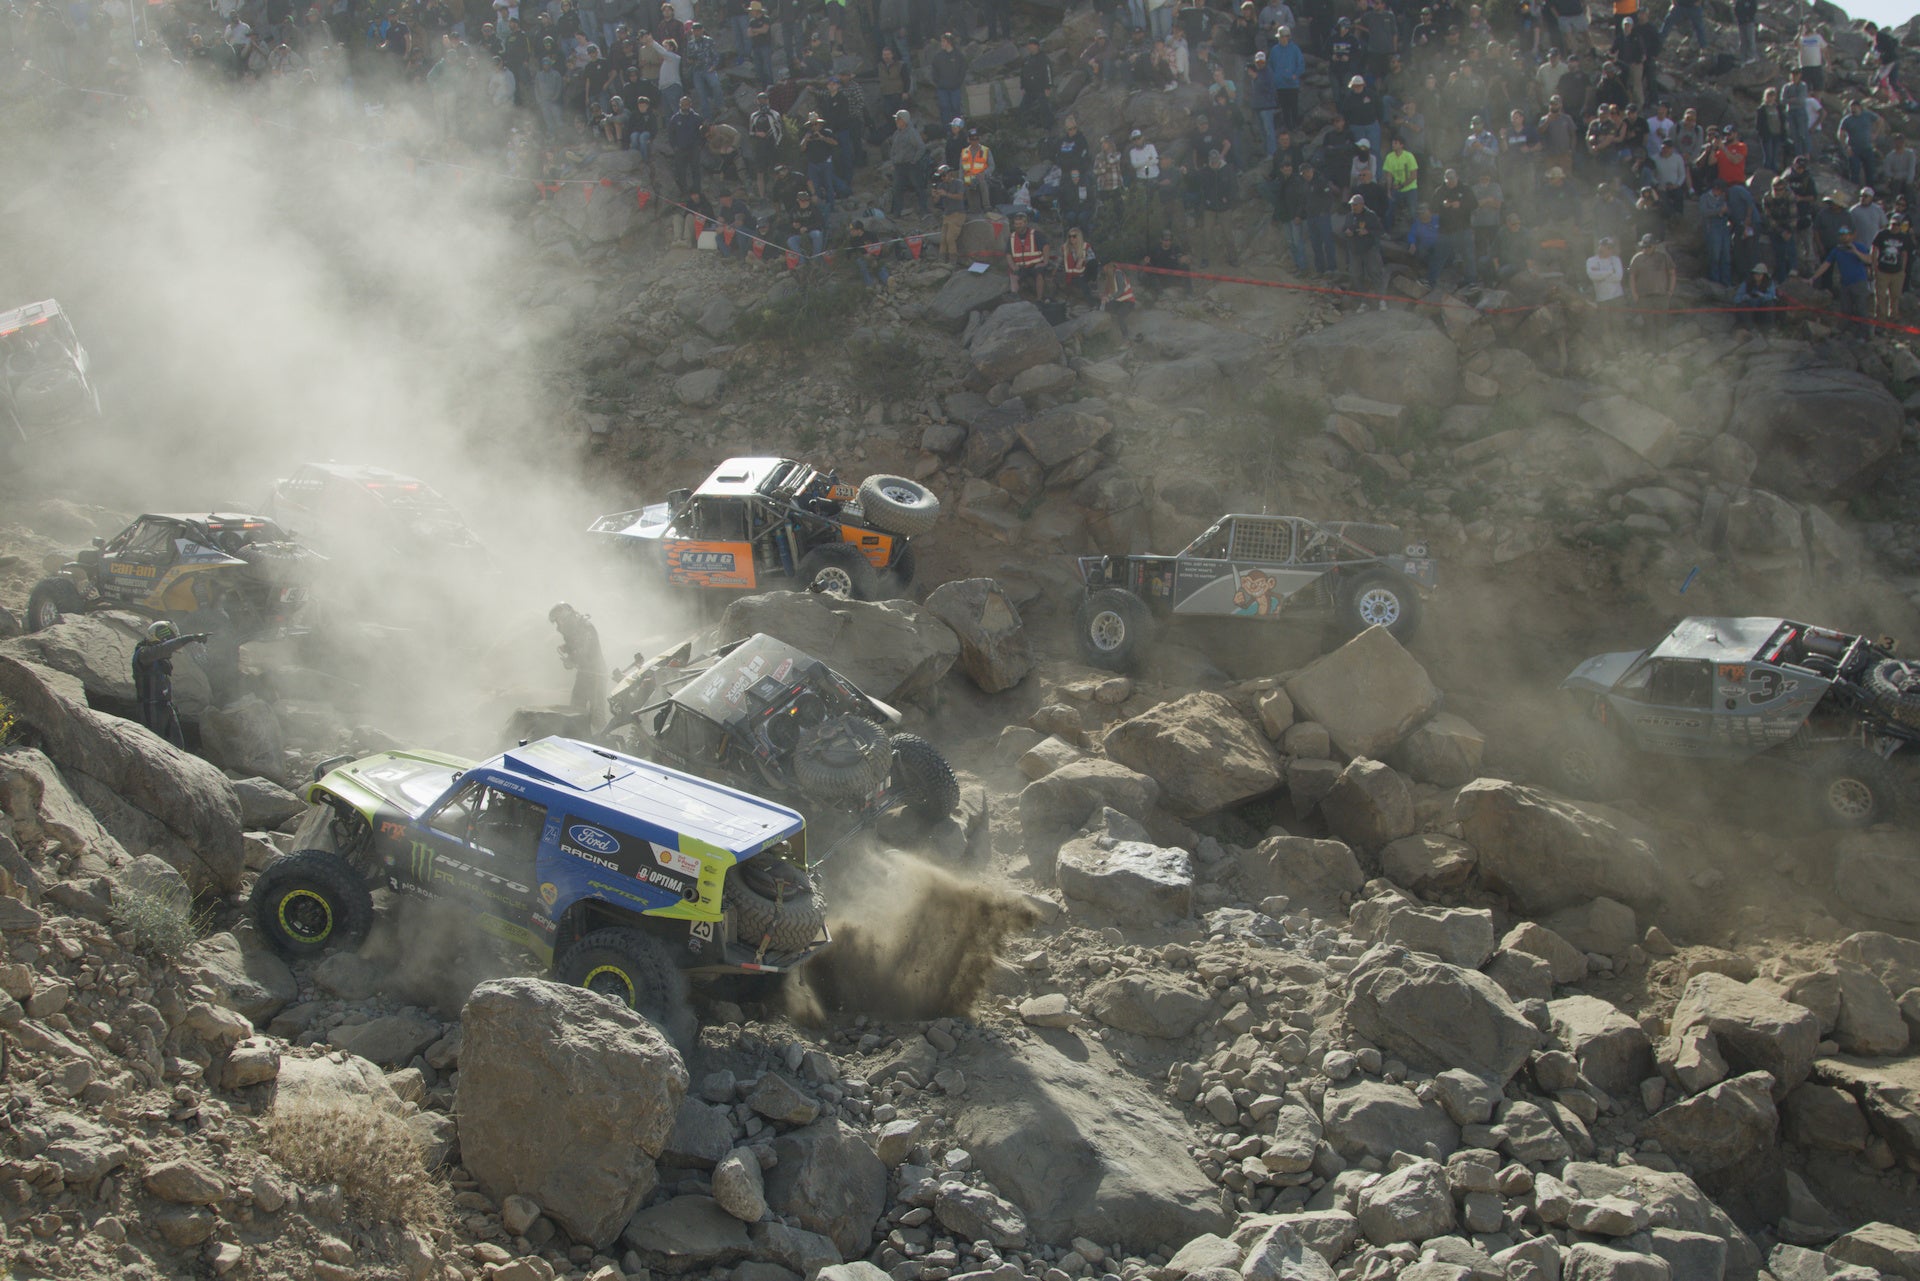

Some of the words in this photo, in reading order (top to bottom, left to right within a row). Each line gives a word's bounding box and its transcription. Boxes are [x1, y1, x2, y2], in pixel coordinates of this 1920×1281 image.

[836, 487, 855, 497] 321
[682, 553, 733, 564] KING
[110, 562, 157, 578] can-am
[1718, 664, 1746, 683] FOX
[1749, 668, 1784, 705] 3
[380, 821, 407, 840] FOX
[577, 827, 610, 851] Ford
[560, 844, 620, 872] RACING
[435, 854, 529, 894] NITTO
[649, 869, 684, 893] OPTIMA
[693, 920, 711, 938] 25
